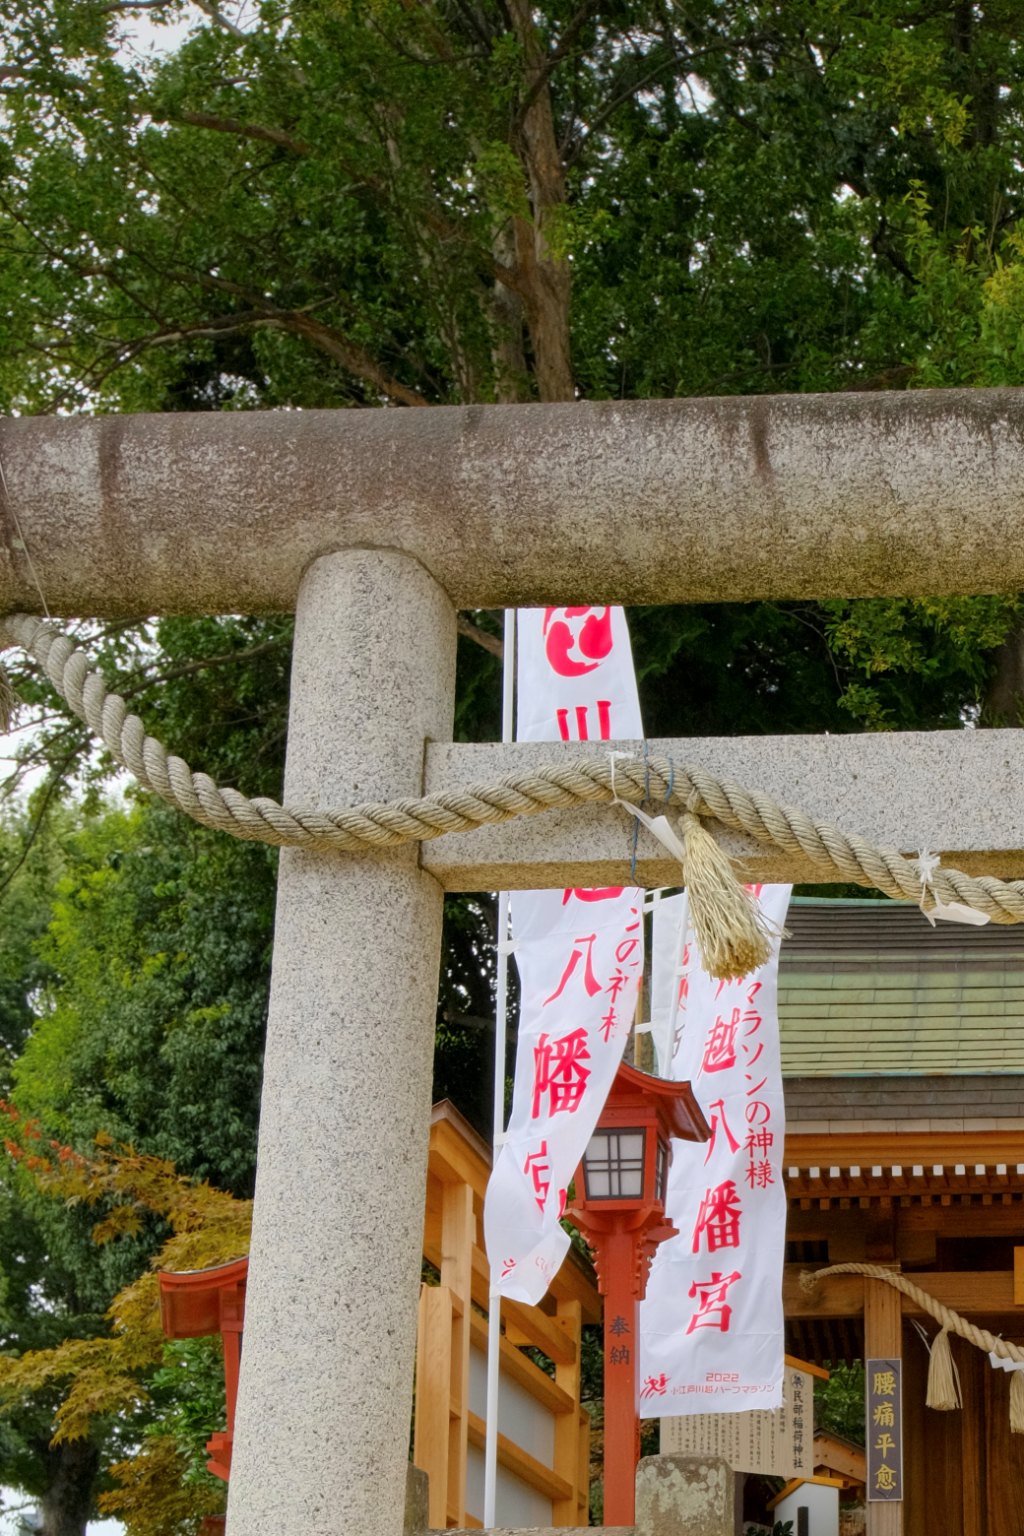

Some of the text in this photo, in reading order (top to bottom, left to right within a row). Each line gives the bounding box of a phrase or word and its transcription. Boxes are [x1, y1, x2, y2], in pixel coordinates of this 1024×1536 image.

[742, 981, 775, 1190] マラソンの神様
[609, 1314, 631, 1366] 奉納
[705, 1372, 740, 1383] 2022
[872, 1370, 897, 1490] 腰痛平愈
